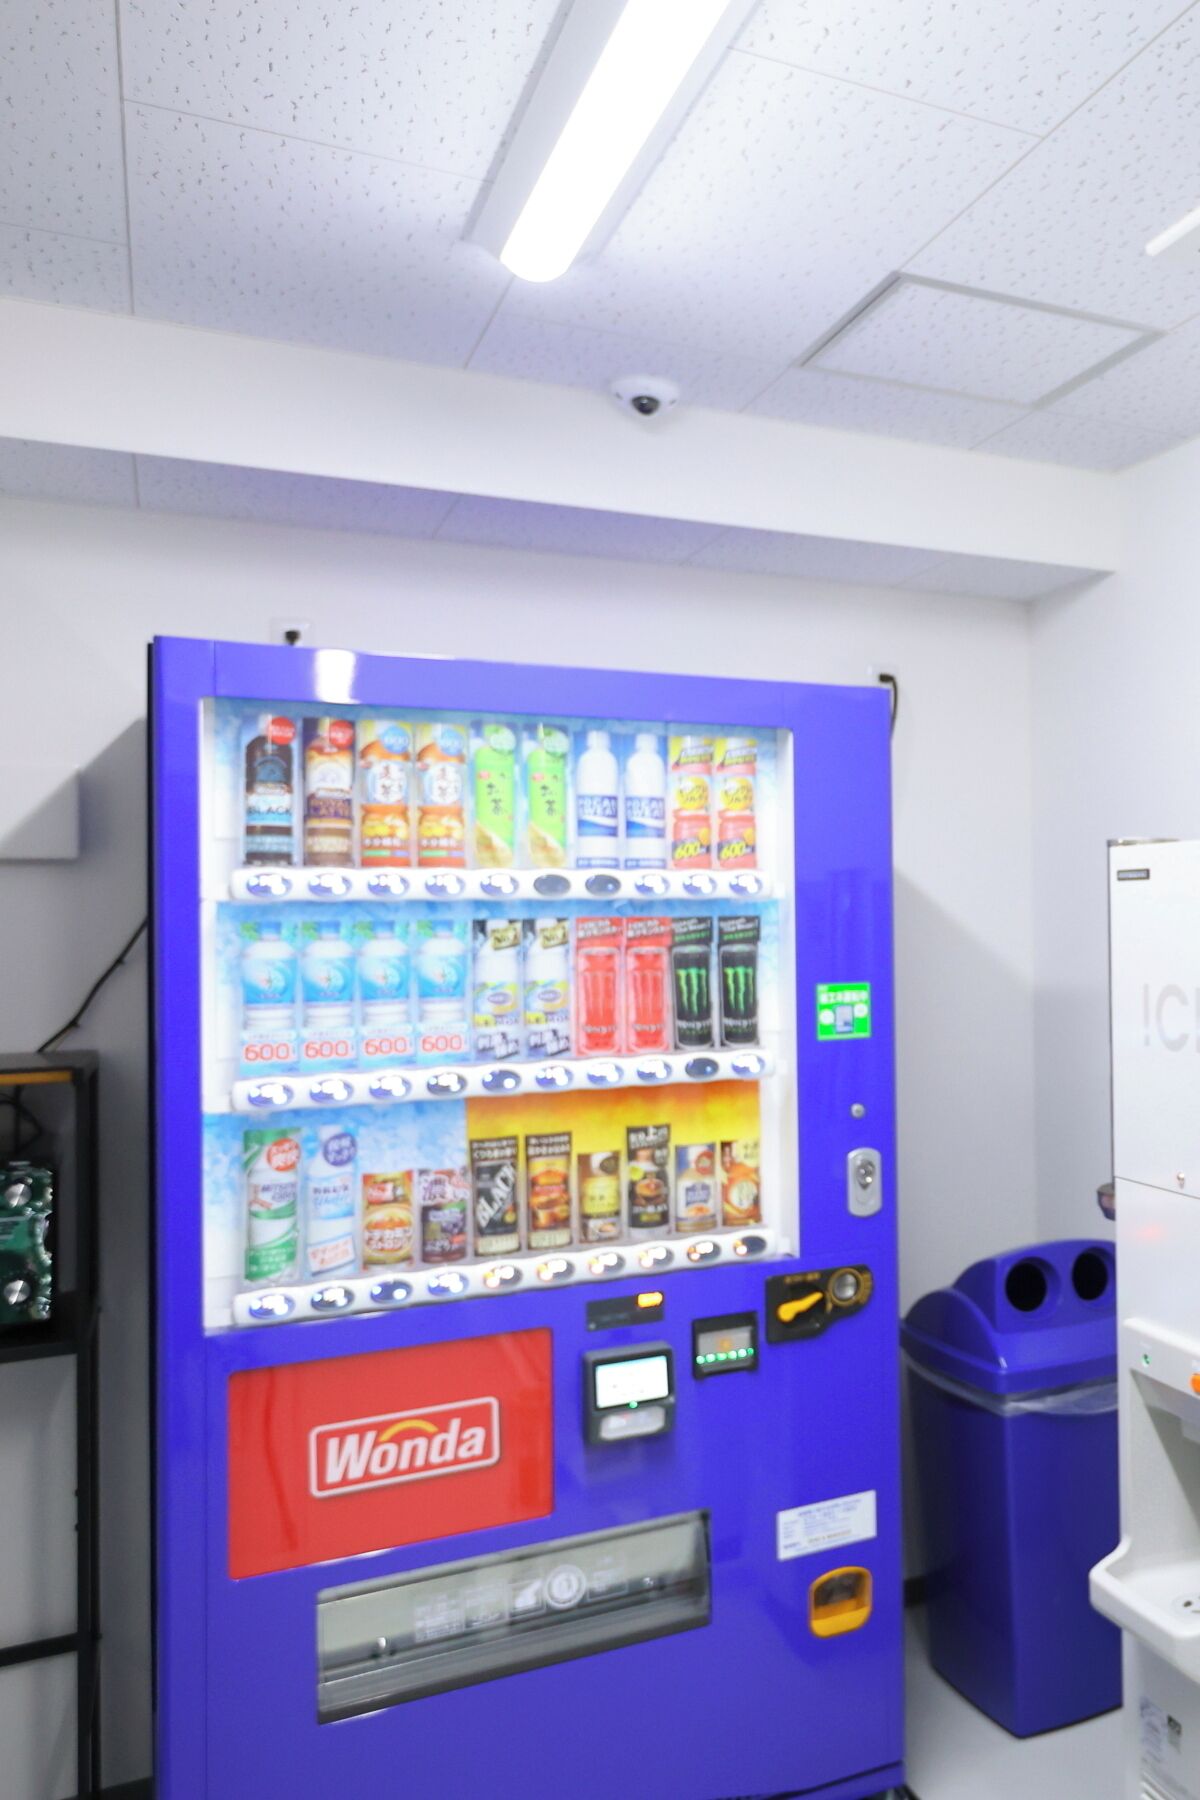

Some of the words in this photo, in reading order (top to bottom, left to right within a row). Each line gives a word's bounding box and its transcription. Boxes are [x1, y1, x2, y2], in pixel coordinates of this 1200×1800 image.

[675, 841, 700, 860] 600
[719, 841, 745, 860] 600
[244, 1043, 290, 1062] 600
[304, 1040, 349, 1059] 600
[364, 1037, 408, 1056] 600
[422, 1035, 463, 1052] 600
[476, 1163, 516, 1228] BLACK
[326, 1417, 486, 1484] Wonda
